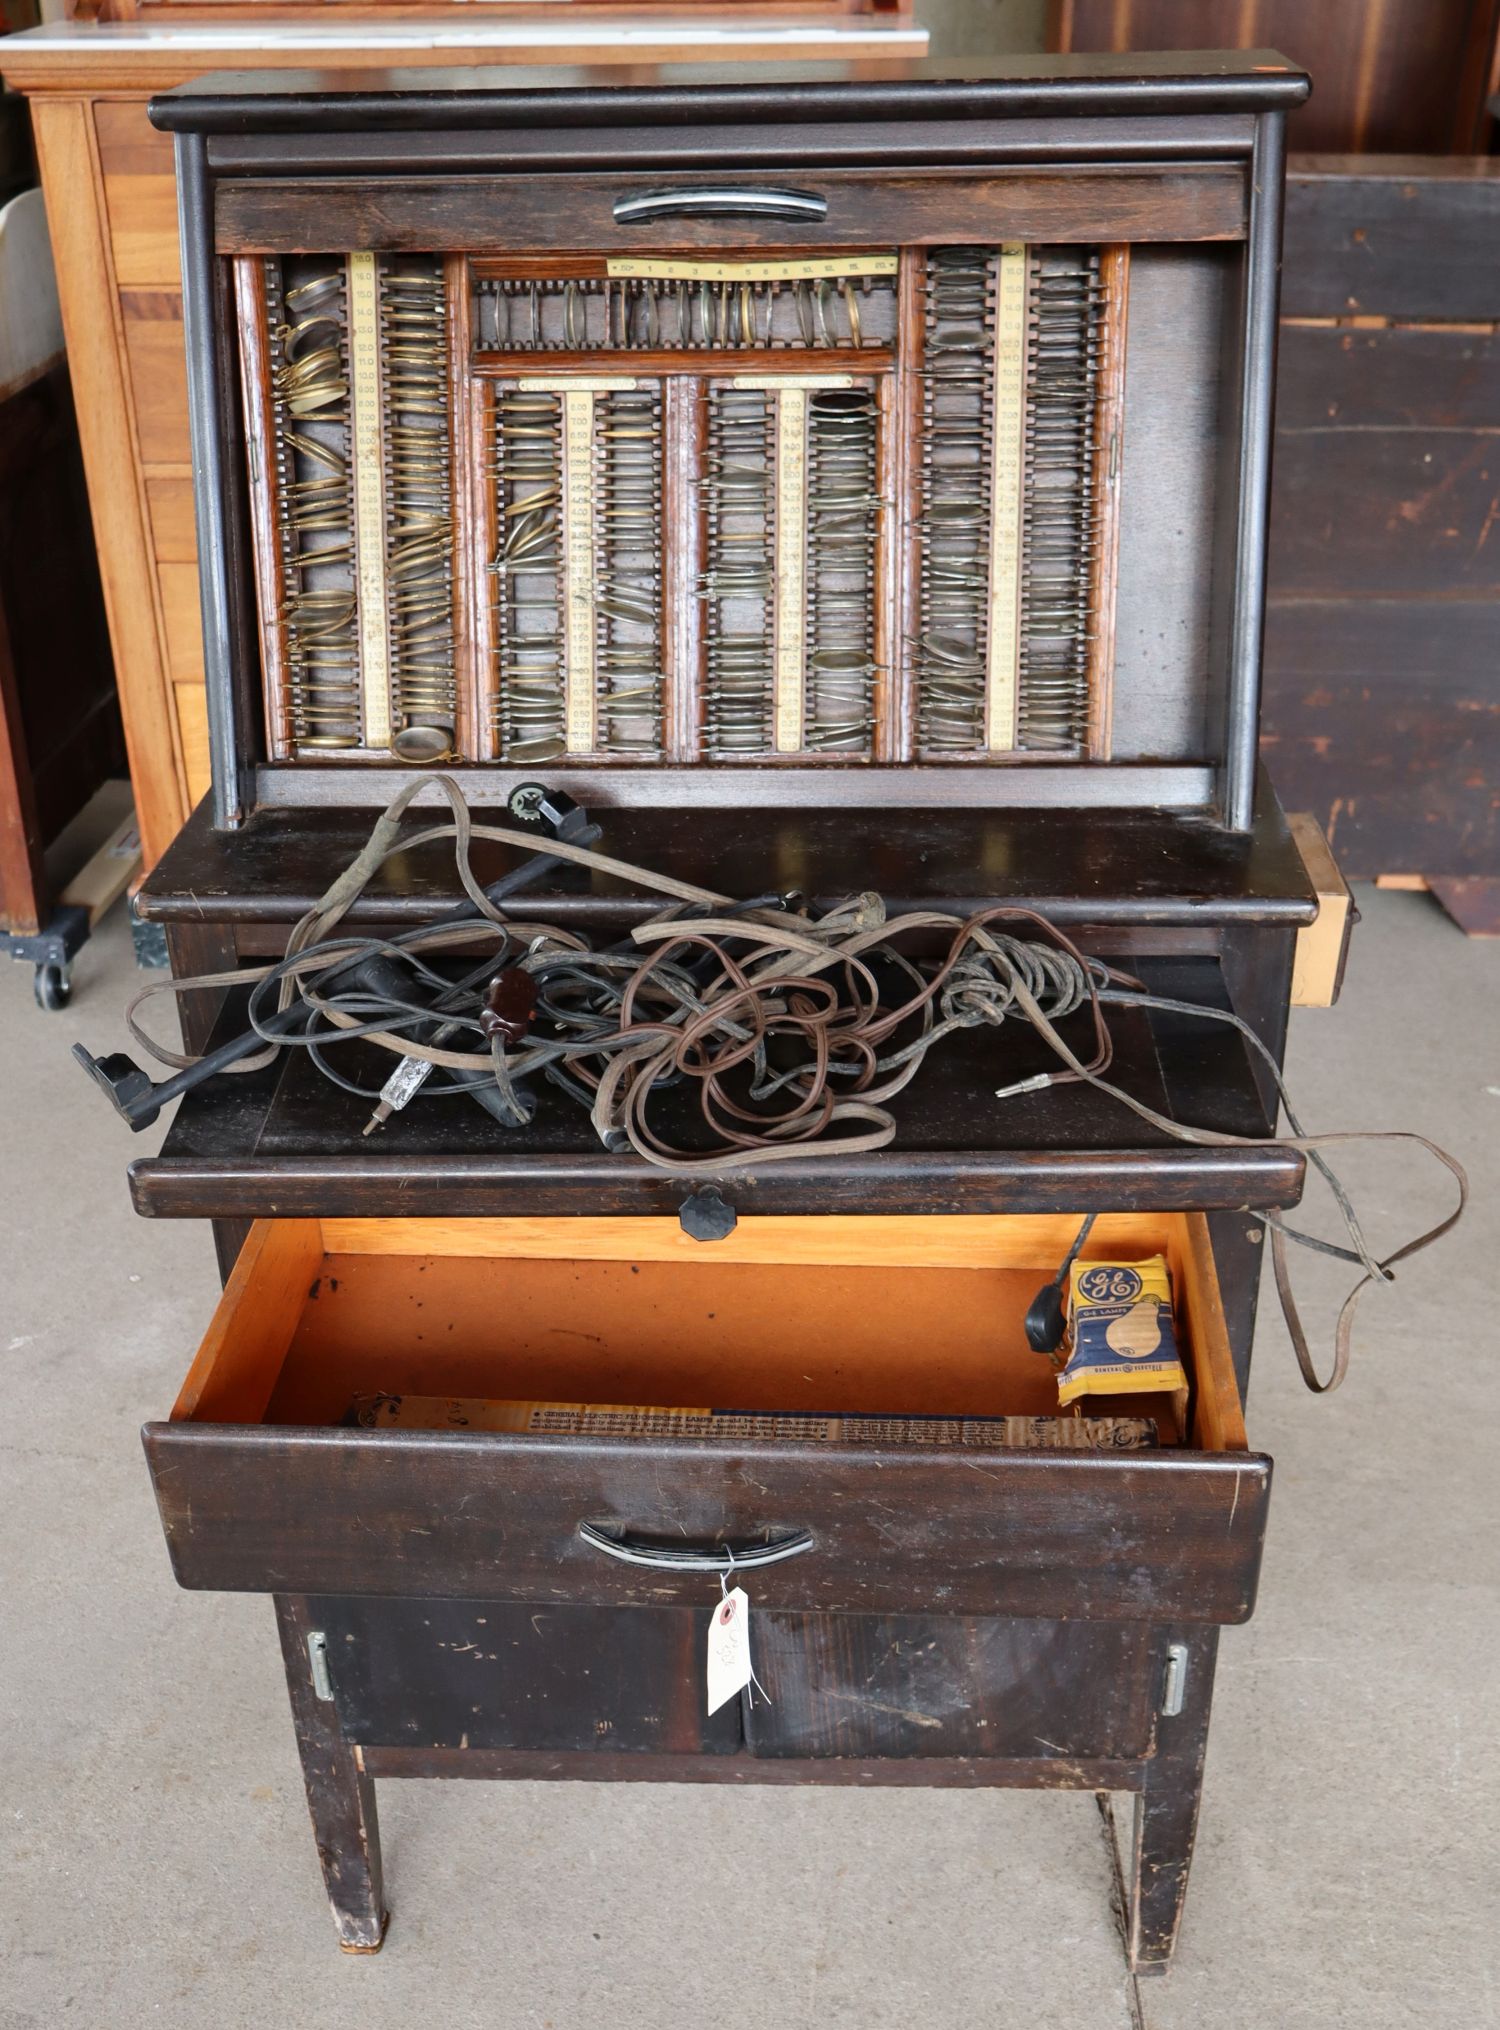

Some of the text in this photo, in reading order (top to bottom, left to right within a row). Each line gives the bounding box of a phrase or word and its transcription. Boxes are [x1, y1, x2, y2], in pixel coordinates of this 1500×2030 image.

[359, 372, 374, 380] 10.0
[571, 417, 588, 425] 7.00
[625, 1413, 682, 1422] FLUORESCENT
[686, 1415, 713, 1423] LAMPS
